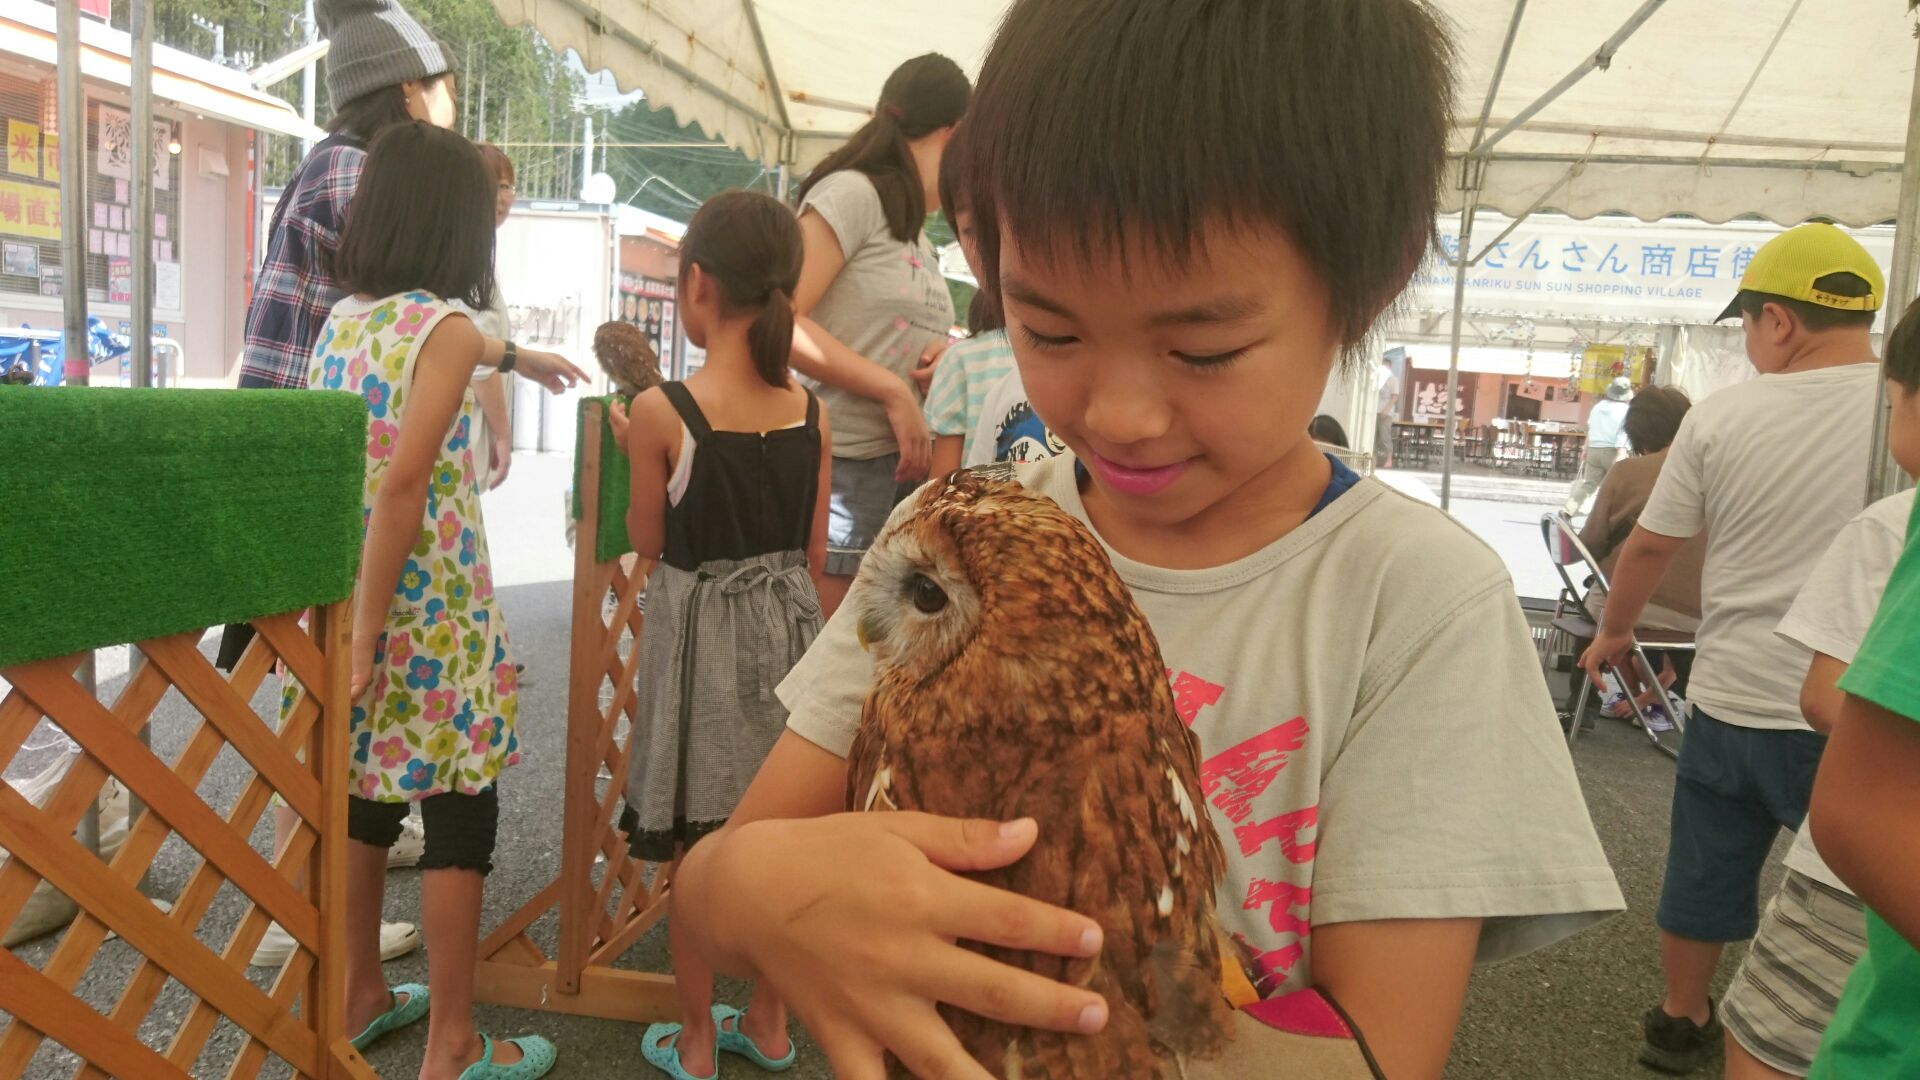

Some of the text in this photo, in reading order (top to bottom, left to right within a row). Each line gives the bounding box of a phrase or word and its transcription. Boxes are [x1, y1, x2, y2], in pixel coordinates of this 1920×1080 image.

[1515, 280, 1541, 290] SUN
[1547, 281, 1572, 292] SUN
[1577, 283, 1642, 295] SHOPPING
[1647, 287, 1702, 298] VILLAGE
